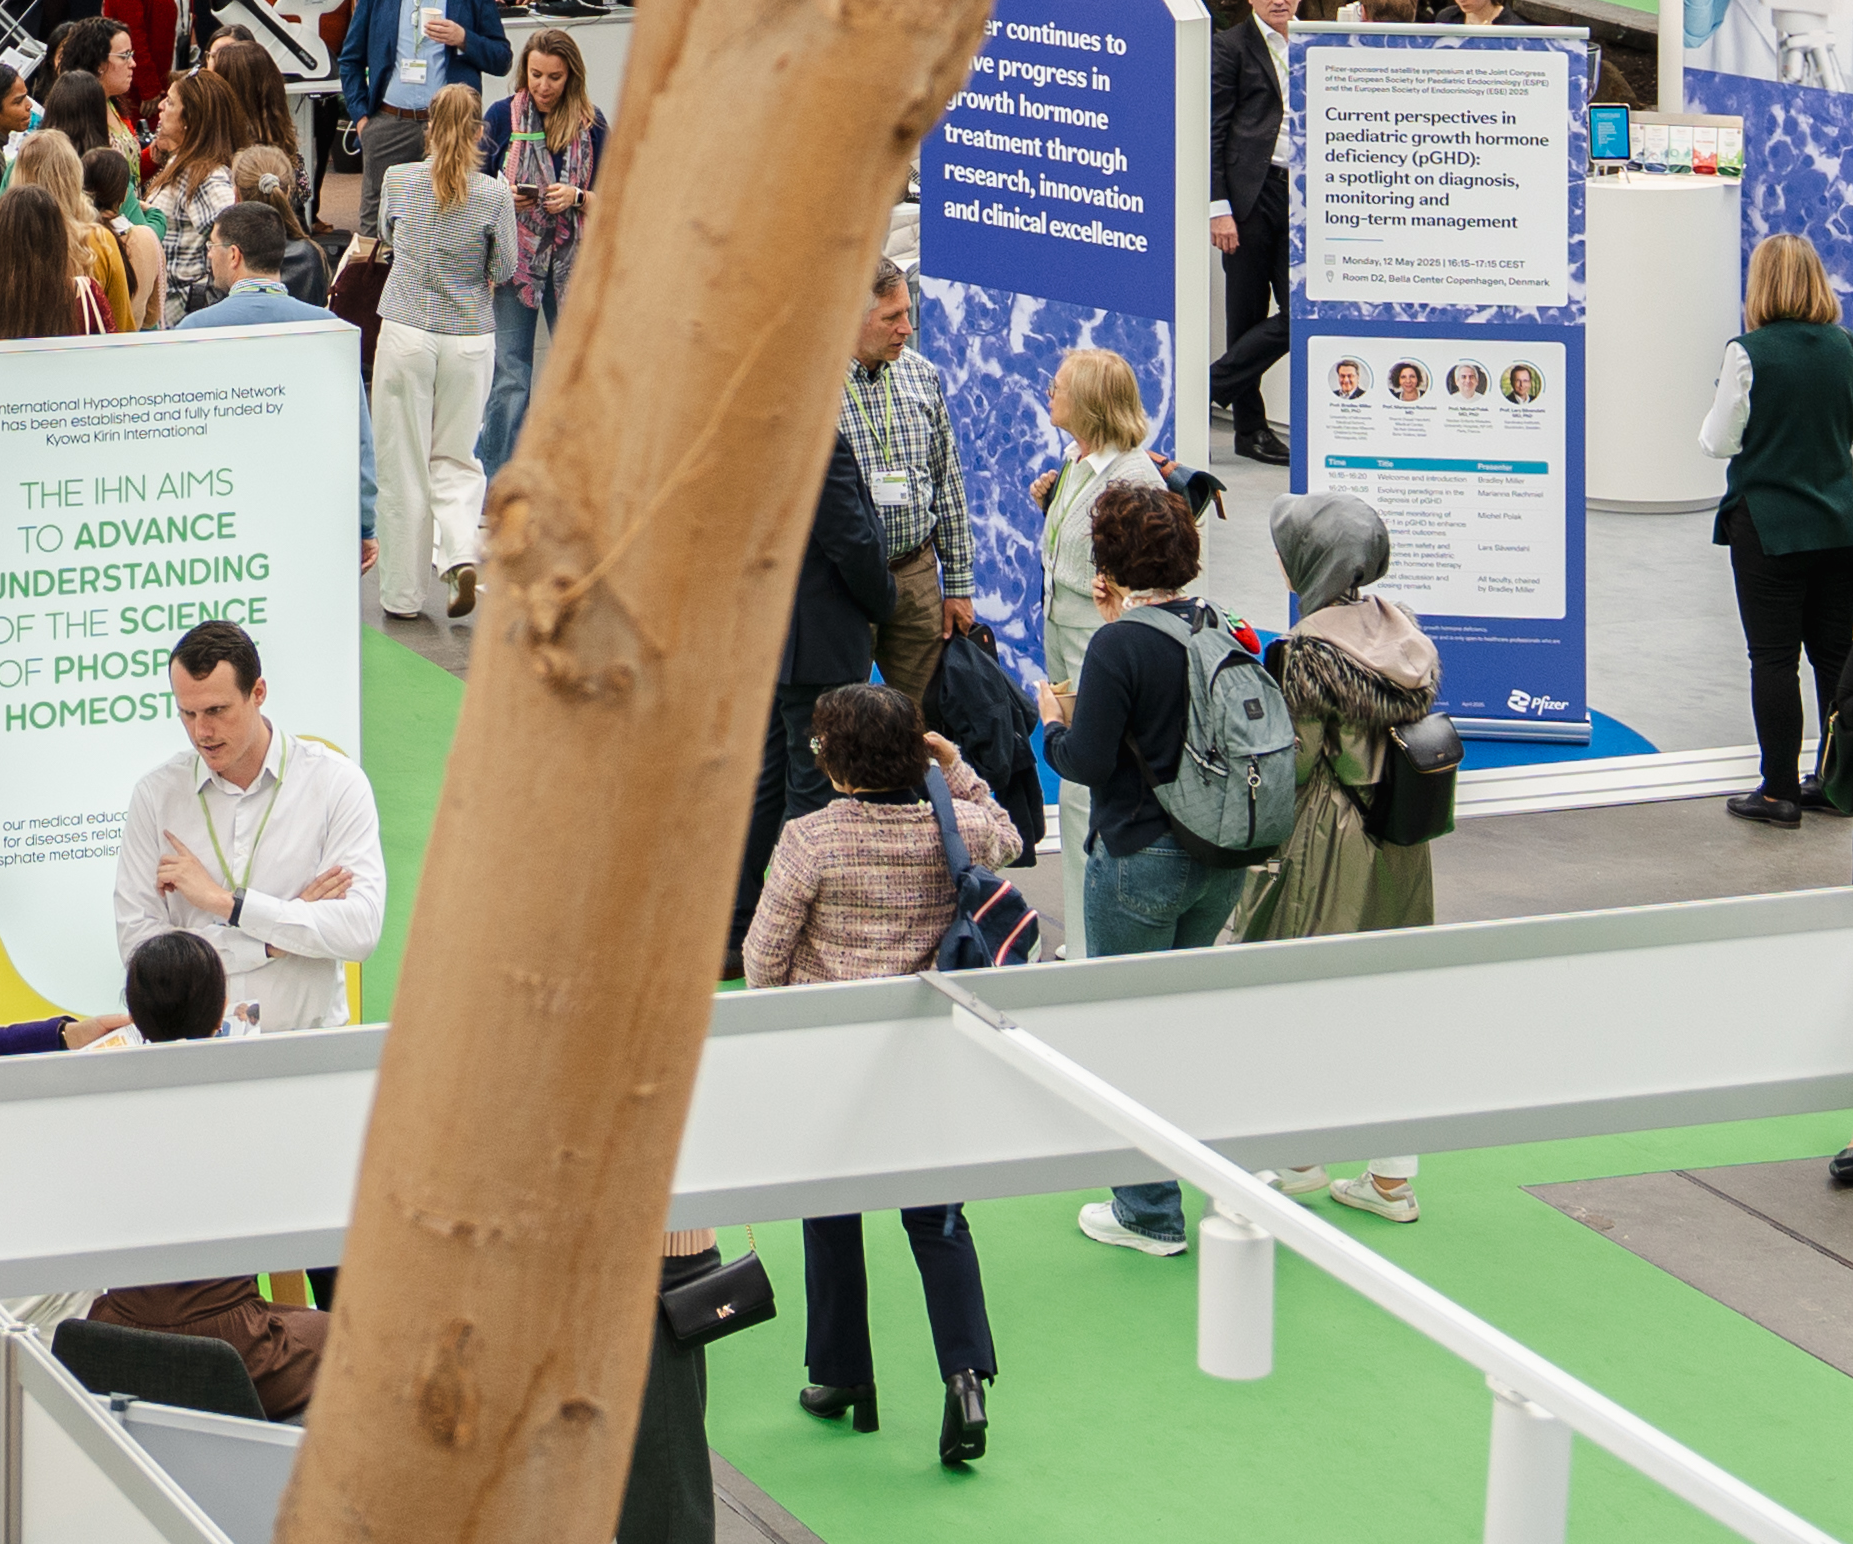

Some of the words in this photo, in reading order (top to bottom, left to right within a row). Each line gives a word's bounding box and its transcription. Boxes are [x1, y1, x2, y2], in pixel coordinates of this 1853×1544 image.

[1006, 22, 1101, 51] continues
[1105, 34, 1126, 55] to
[999, 60, 1087, 88] progress
[1092, 67, 1110, 91] in
[946, 91, 1014, 114] growth
[1020, 94, 1108, 129] hormone
[1325, 107, 1390, 122] Current
[1395, 110, 1497, 126] perspectives
[1502, 111, 1516, 124] in
[944, 123, 1042, 157] treatment
[1046, 137, 1127, 175] through
[1326, 129, 1407, 144] paediatric
[1412, 131, 1470, 147] growth
[1476, 131, 1549, 146] hormone
[1325, 148, 1407, 167] deficiency
[1412, 151, 1480, 167] (pGHD):
[945, 164, 1036, 198] research,
[1039, 173, 1144, 214] innovation
[1325, 173, 1334, 182] a
[1339, 170, 1410, 187] spotlight
[1415, 176, 1434, 185] on
[1439, 172, 1519, 189] diagnosis,
[1326, 191, 1414, 209] monitoring
[1419, 193, 1449, 206] and
[944, 200, 979, 222] and
[982, 203, 1046, 234] clinical
[1049, 220, 1147, 252] excellence
[1326, 211, 1406, 228] long-term
[1412, 217, 1517, 230] management
[83, 388, 229, 411] Hypophosphataemia
[232, 384, 285, 399] Network
[20, 479, 83, 510] THE
[96, 475, 145, 504] IHN
[157, 468, 233, 500] AIMS
[17, 524, 63, 553] TO
[74, 512, 236, 550] ADVANCE
[45, 609, 108, 640] THE
[120, 597, 268, 635] SCIENCE
[55, 645, 176, 688] PHOSP
[6, 686, 181, 732] HOMEOST
[1531, 695, 1569, 715] Pfizer
